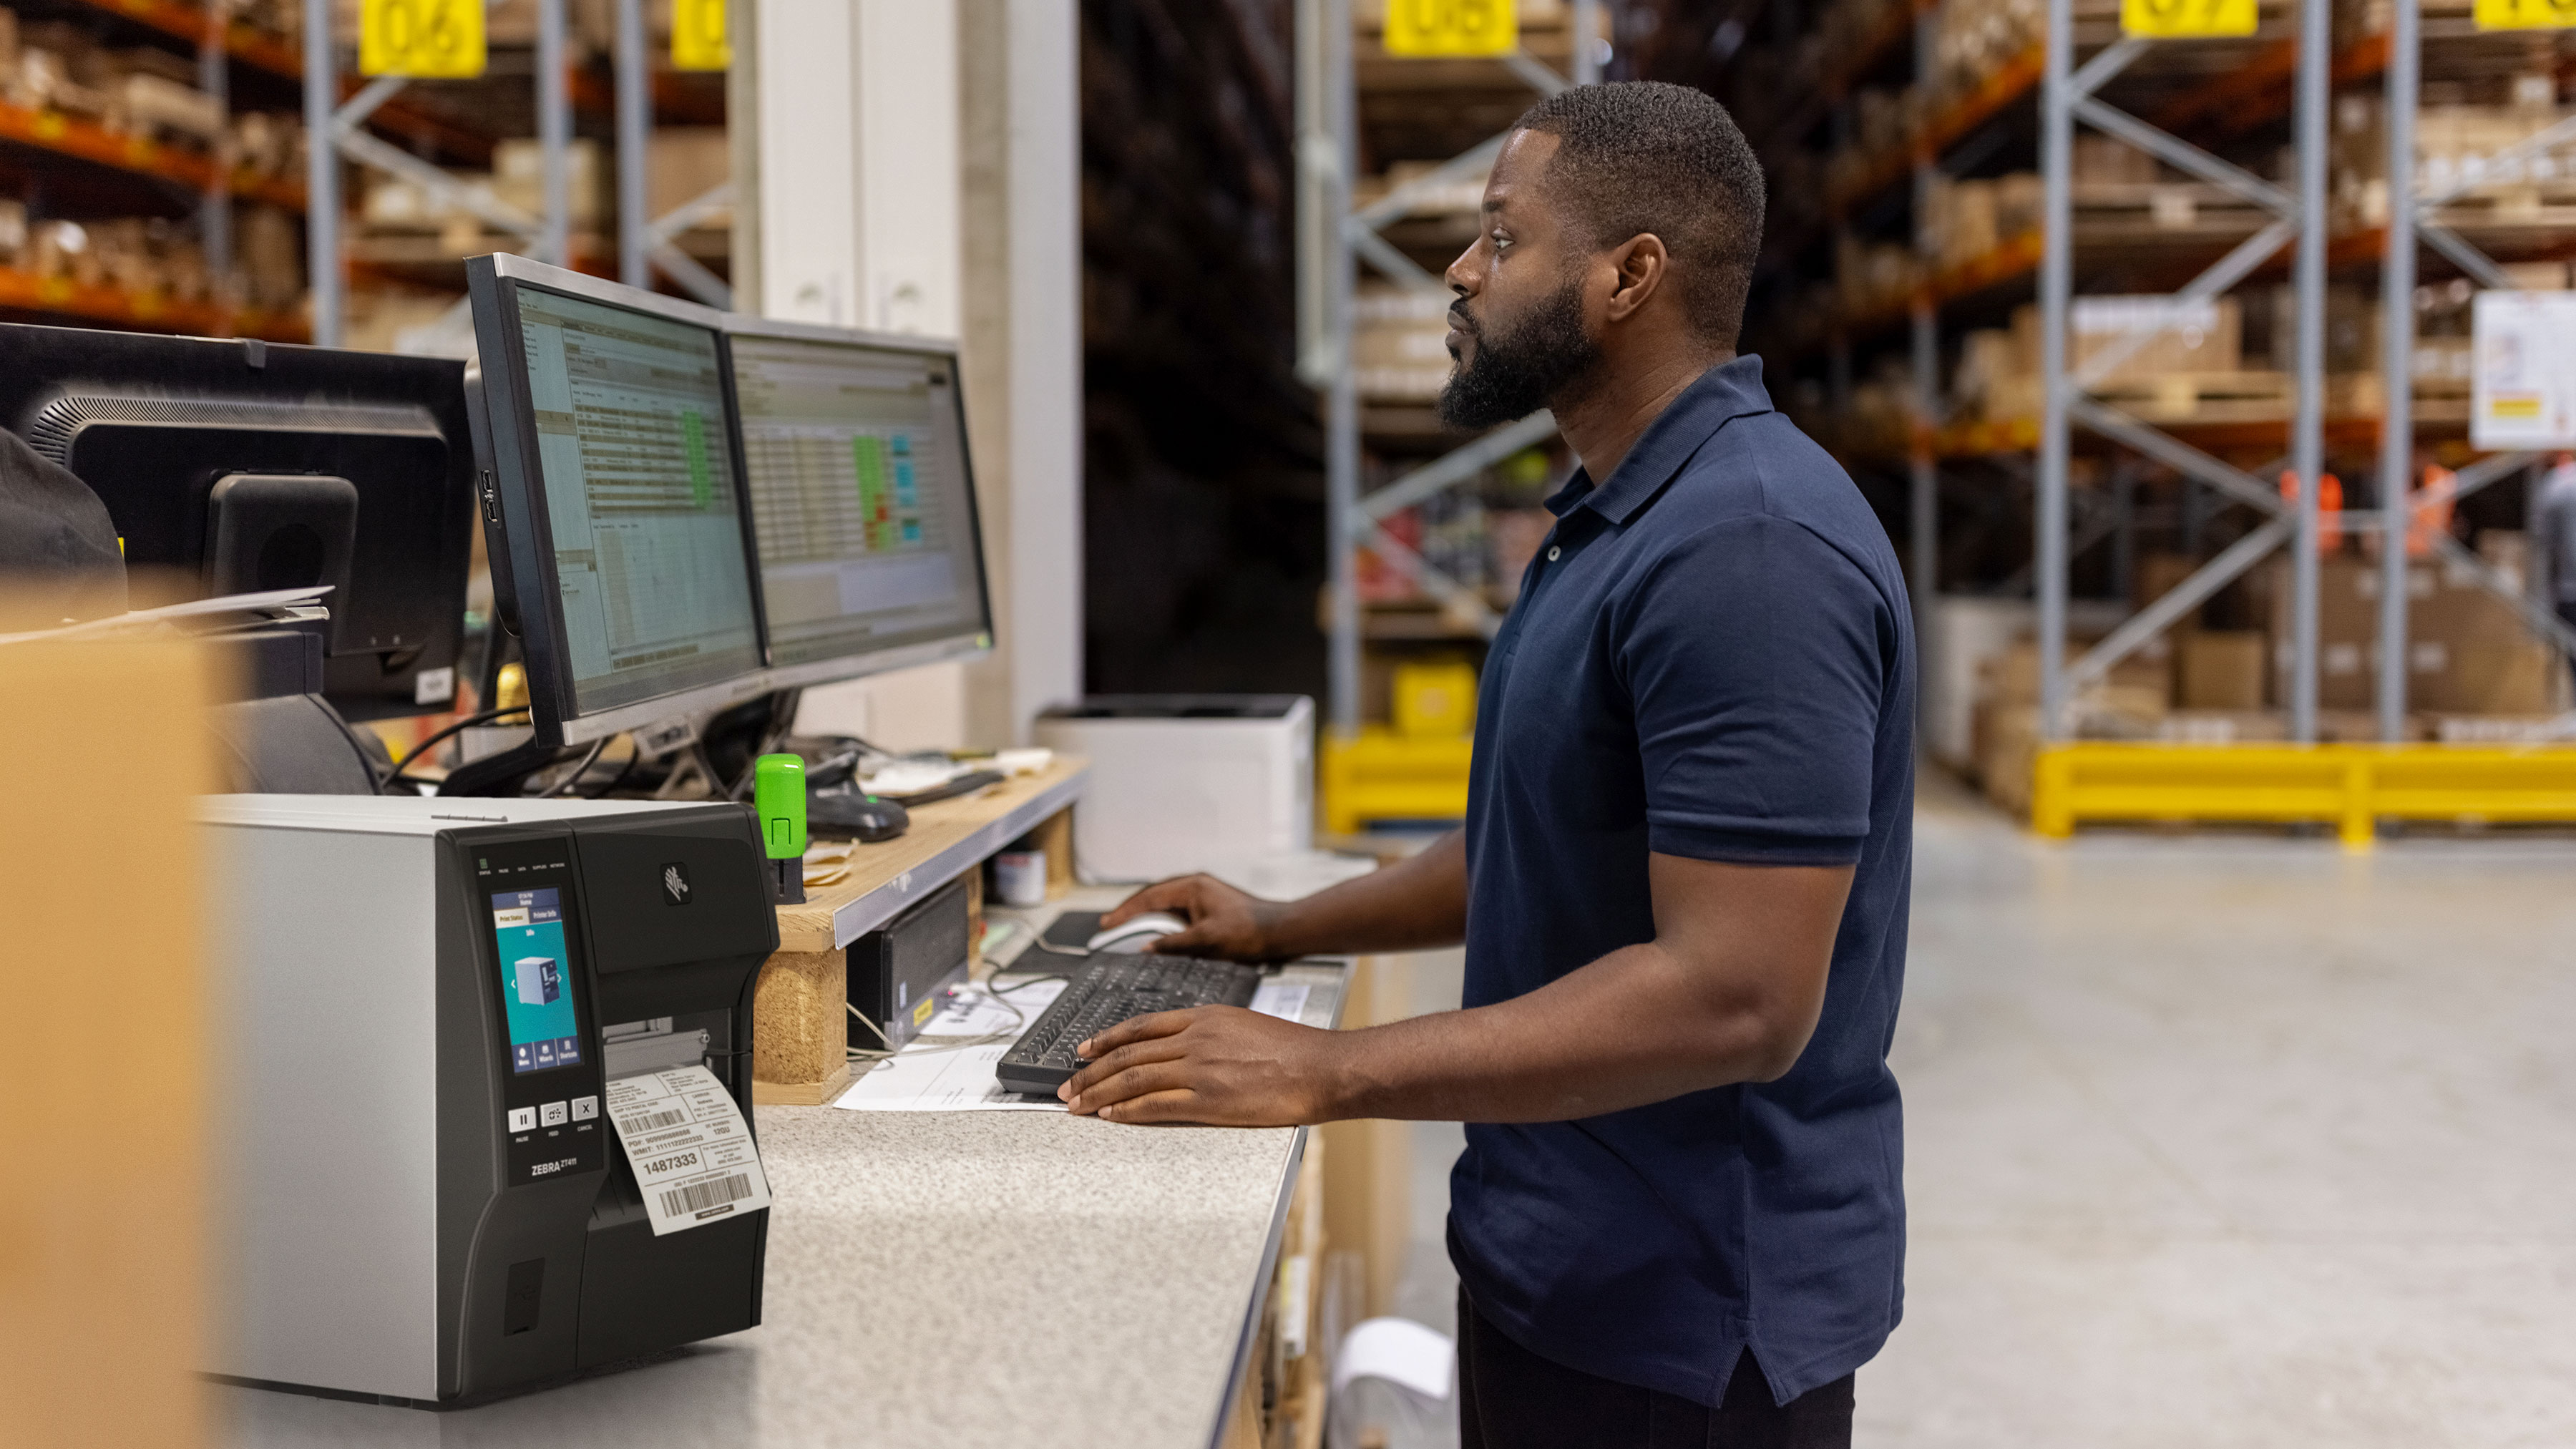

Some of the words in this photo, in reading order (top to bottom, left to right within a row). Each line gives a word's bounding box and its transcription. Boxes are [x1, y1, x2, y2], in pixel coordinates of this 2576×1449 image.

[378, 0, 459, 57] 06
[632, 1146, 654, 1156] WMIT:
[532, 1161, 560, 1176] ZEBRA
[560, 1157, 577, 1168] ZT411
[643, 1152, 698, 1176] 1487333
